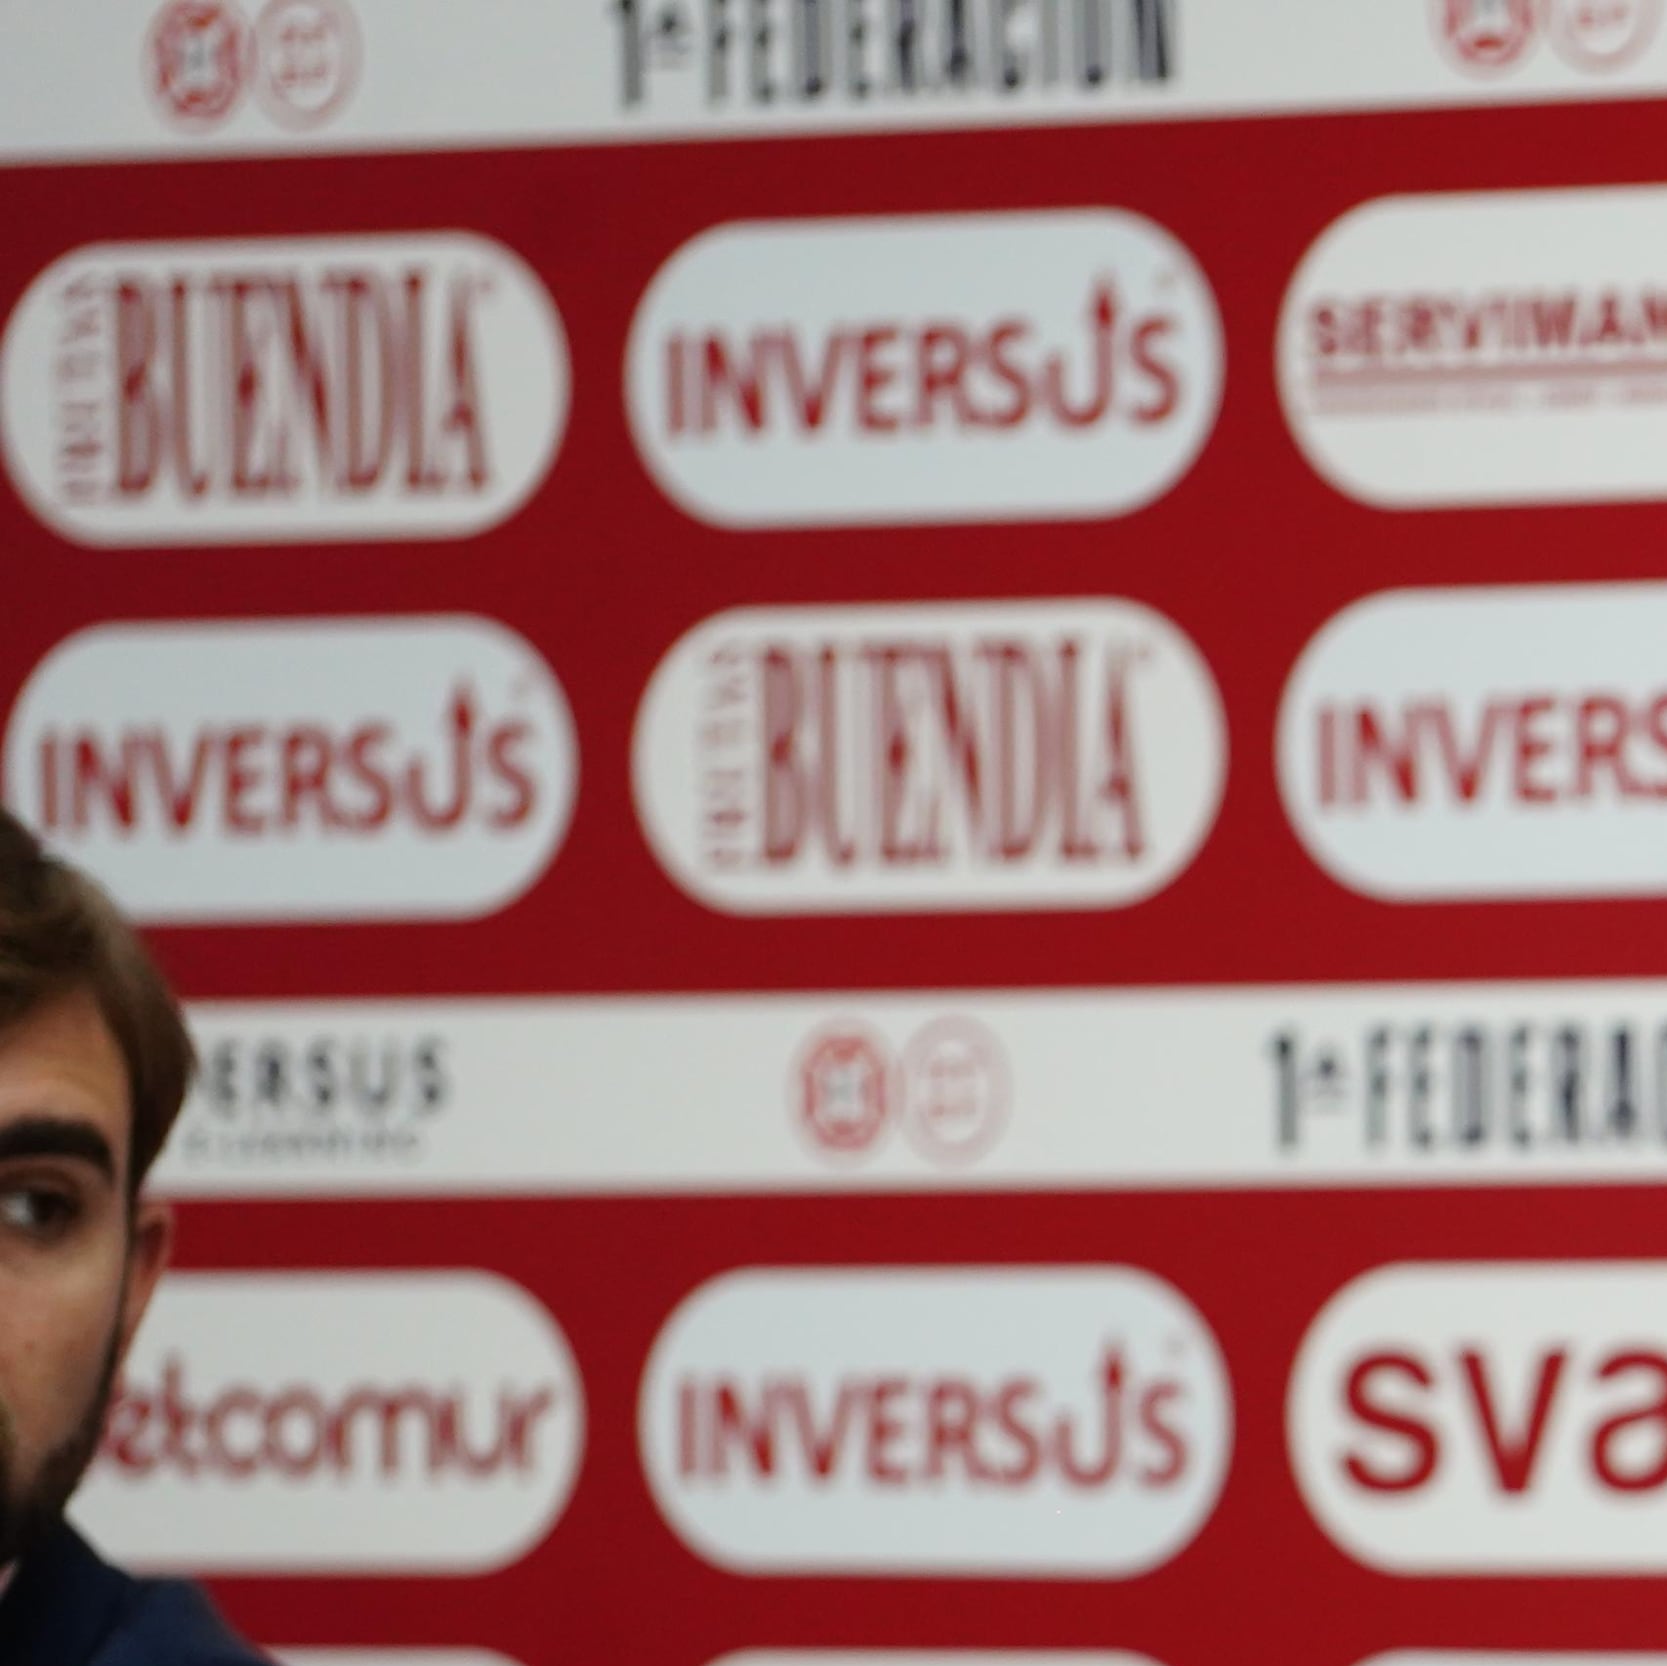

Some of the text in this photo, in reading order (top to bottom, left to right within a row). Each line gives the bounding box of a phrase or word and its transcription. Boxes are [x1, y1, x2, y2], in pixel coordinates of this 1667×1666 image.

[662, 265, 1190, 446] INVERSUS
[35, 672, 542, 846] INVERSUS
[208, 1035, 450, 1116] ERSUS
[676, 1332, 1186, 1494] INVERSUS
